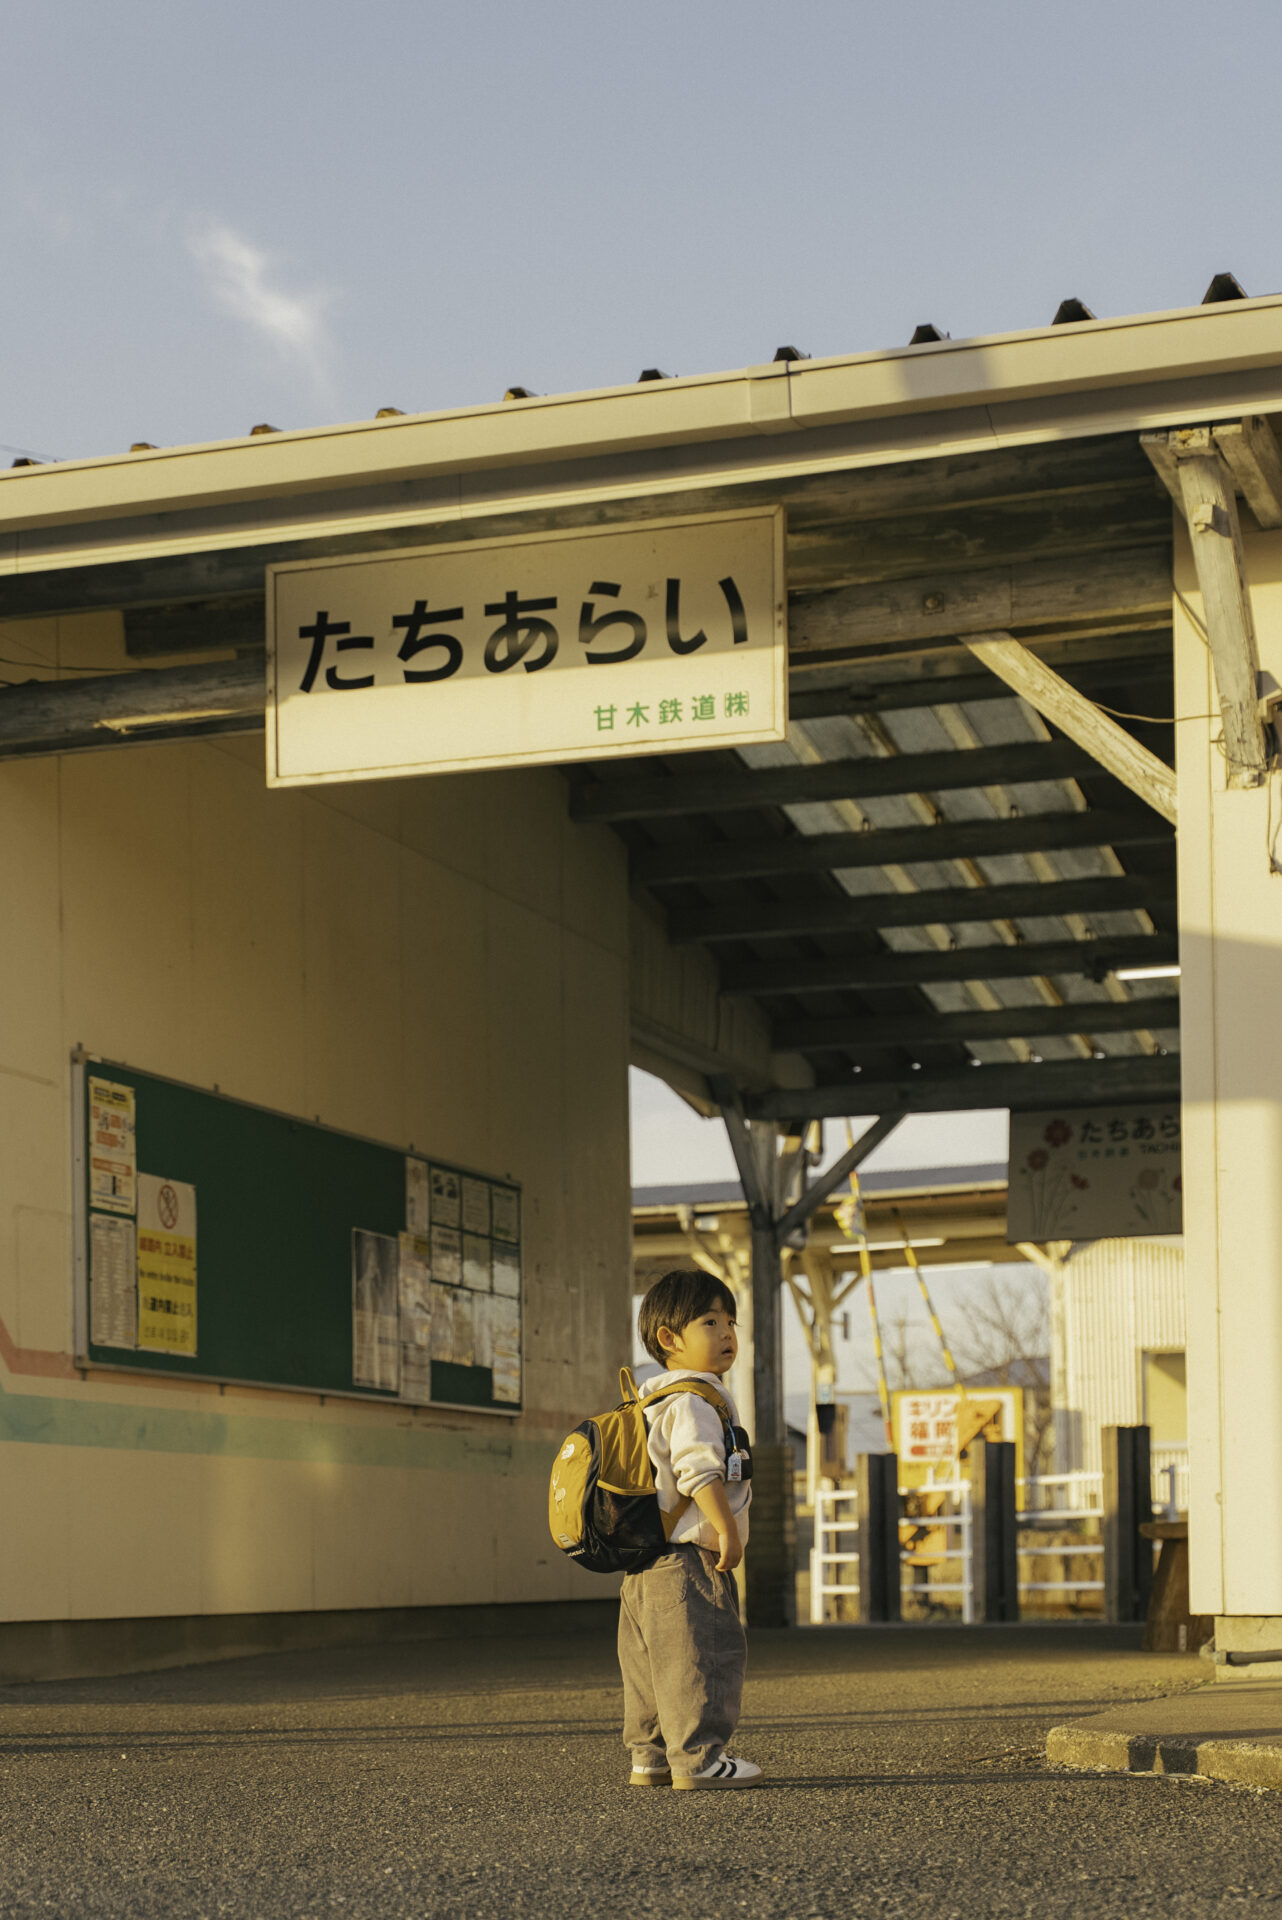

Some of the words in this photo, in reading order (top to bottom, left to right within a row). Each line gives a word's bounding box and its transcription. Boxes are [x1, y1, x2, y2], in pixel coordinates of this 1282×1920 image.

[299, 576, 748, 693] たちあらい
